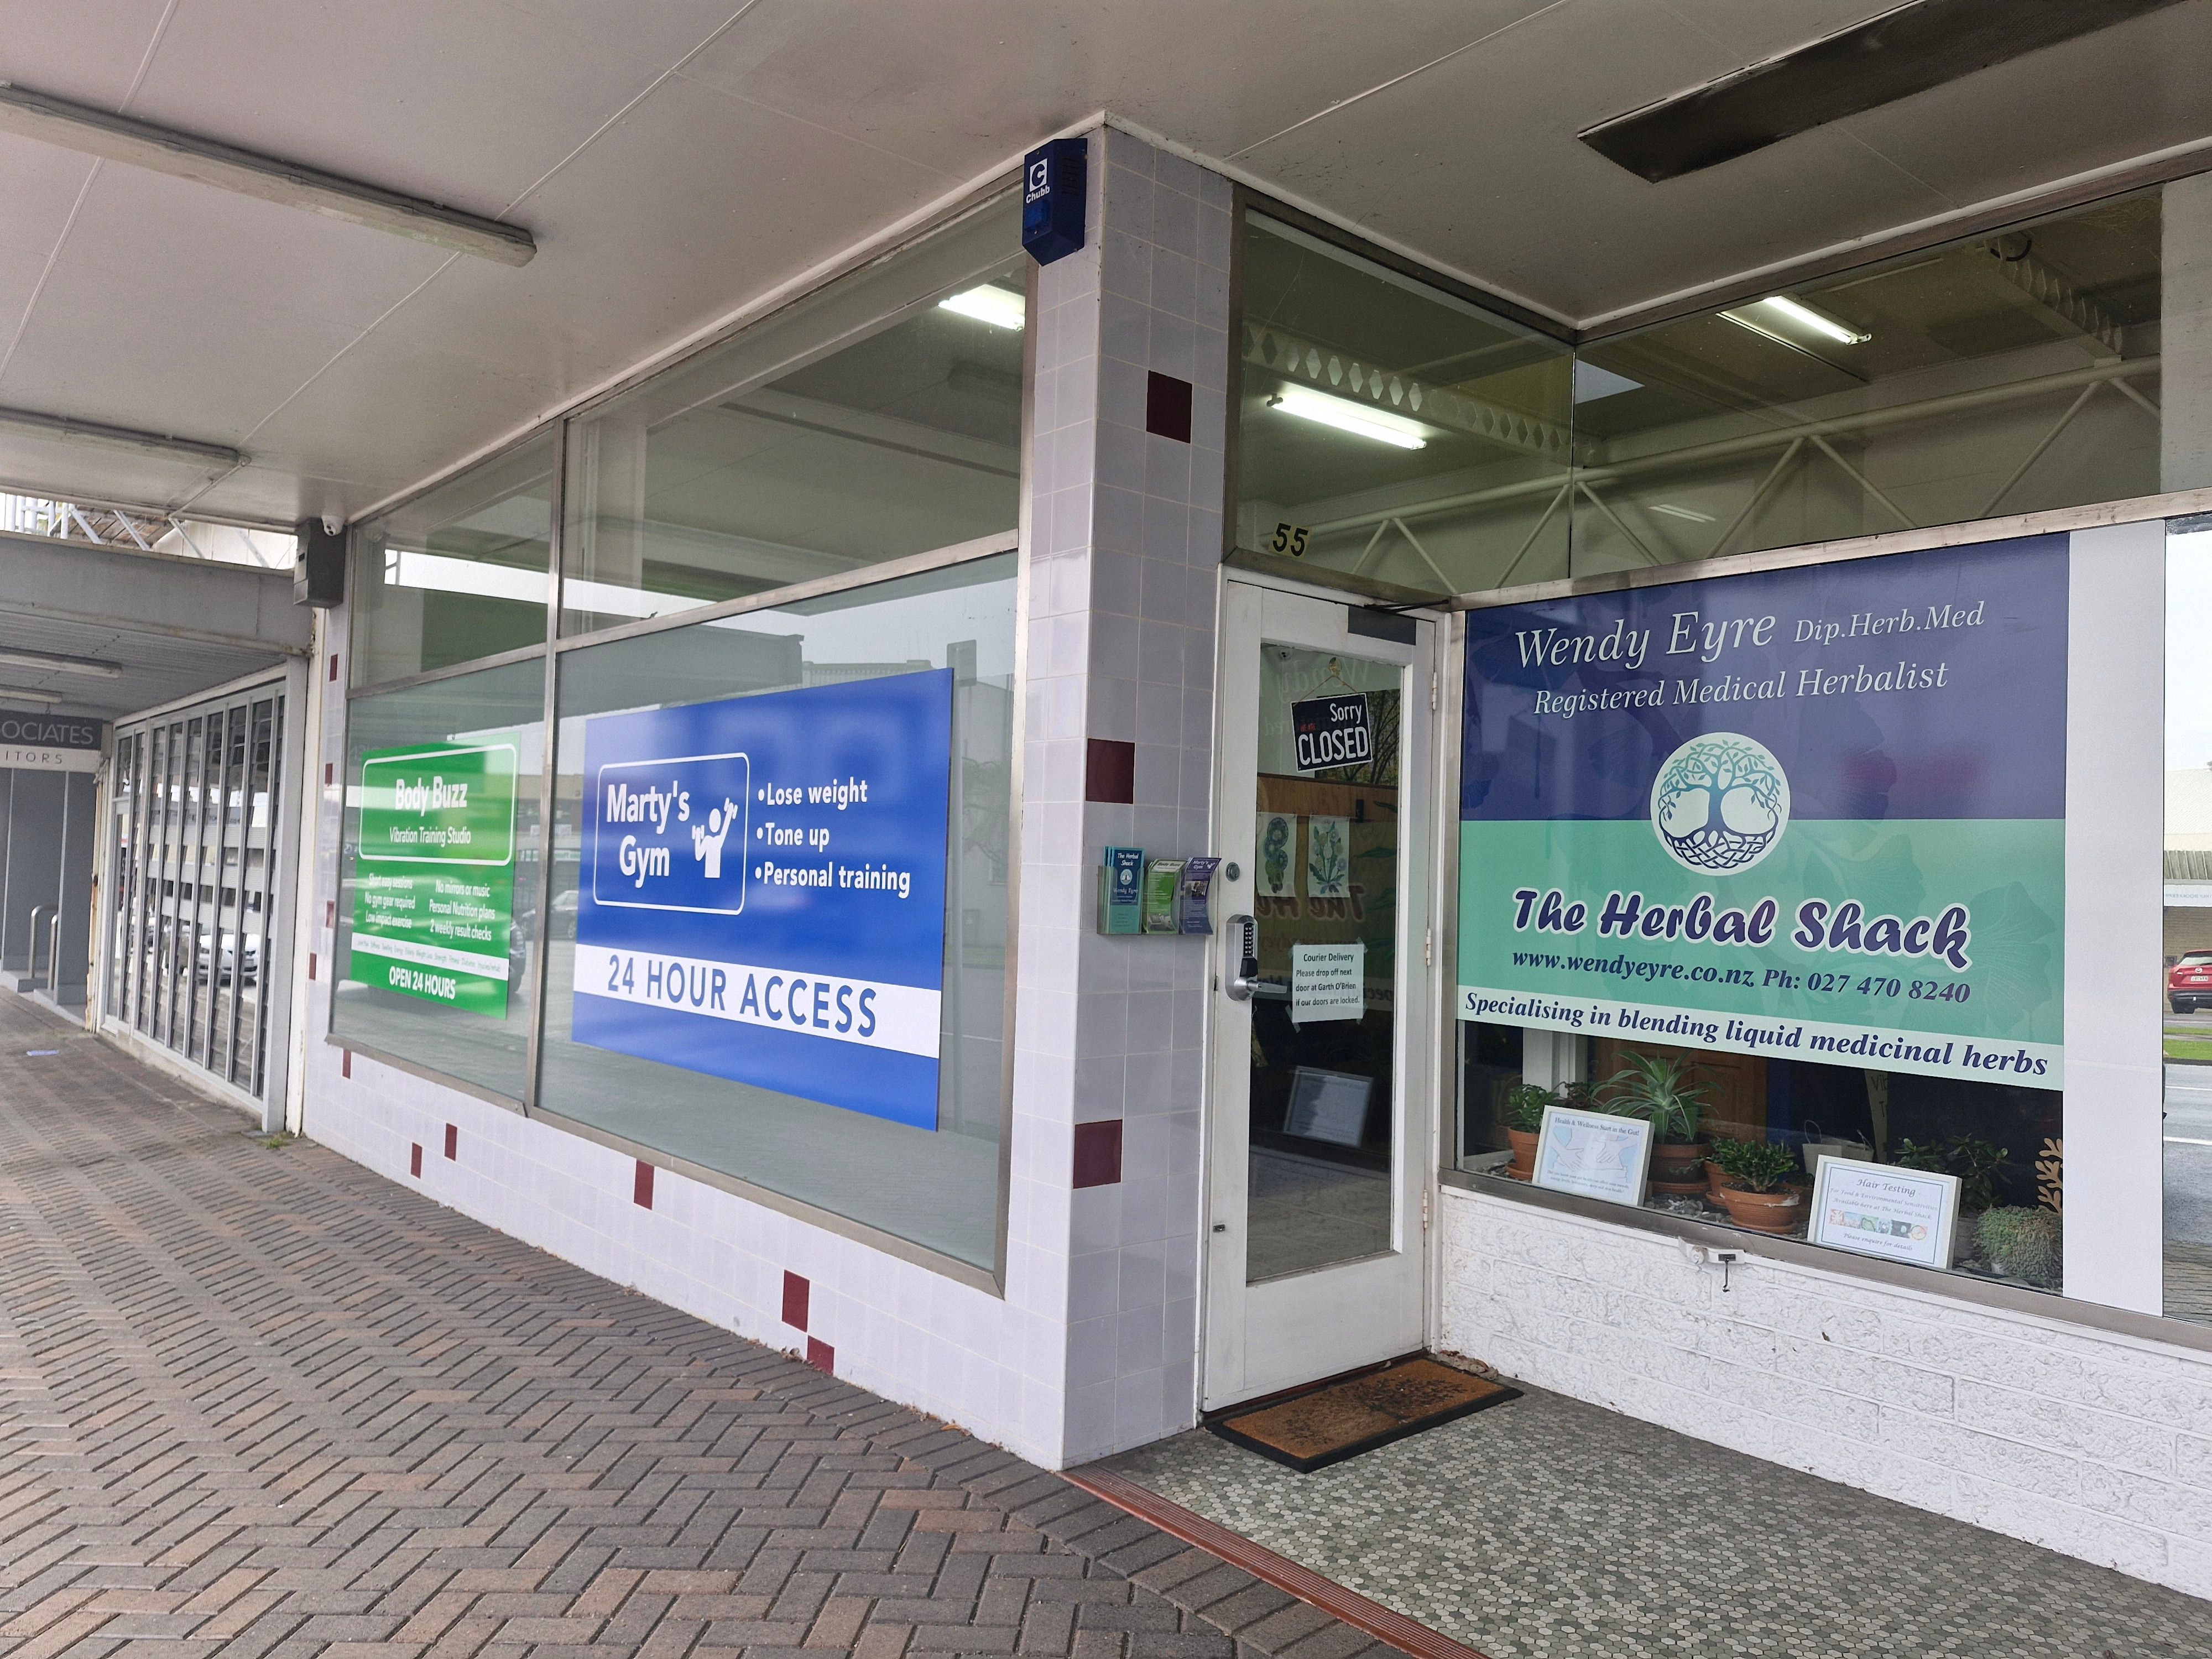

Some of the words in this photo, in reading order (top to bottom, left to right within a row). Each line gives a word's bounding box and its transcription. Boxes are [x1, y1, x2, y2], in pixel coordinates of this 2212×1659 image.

[1273, 523, 1308, 556] 55
[1515, 619, 1650, 669] Wendy
[1666, 611, 1776, 663] Eyre
[1794, 601, 1985, 645] Dip.Herb.Med
[1533, 680, 1665, 719] Registered
[1673, 671, 1787, 705] Medical
[1796, 661, 1949, 697] Herbalist
[1329, 703, 1362, 724] Sorry
[1, 721, 93, 744] OCIATES
[6, 750, 62, 764] ITORS
[1026, 738, 1050, 757] Chubb
[1298, 727, 1369, 765] CLOSED
[395, 778, 429, 817] Body
[432, 776, 468, 808] Buzz
[766, 782, 802, 805] Lose
[808, 776, 868, 811] weight
[607, 780, 690, 834] Marty's
[390, 827, 418, 843] Vibration
[419, 827, 446, 847] Training
[447, 826, 471, 844] Studio
[765, 822, 803, 846] Tone
[808, 827, 830, 852] up
[619, 835, 670, 889] Gym
[436, 879, 444, 893] No
[445, 880, 465, 895] mirrors
[465, 885, 472, 895] or
[473, 883, 490, 898] music
[764, 862, 833, 888] Personal
[838, 864, 911, 899] training
[365, 891, 372, 904] No
[394, 895, 415, 911] required
[429, 899, 452, 914] Personal
[452, 901, 478, 917] Nutrition
[478, 904, 495, 922] plans
[366, 910, 375, 923] Low
[430, 919, 435, 932] 2
[435, 920, 454, 939] weekly
[455, 923, 471, 938] result
[471, 924, 492, 941] checks
[1515, 890, 1585, 931] The
[1599, 892, 1776, 944] Herbal
[1794, 901, 1969, 969] Shack
[1303, 953, 1327, 962] Courier
[1328, 953, 1354, 963] Delivery
[389, 966, 411, 989] OPEN
[412, 971, 423, 992] 24
[425, 974, 456, 1000] HOURS
[1316, 969, 1329, 978] drop
[1512, 951, 1755, 987] www.wendyeyre.co.nz
[1761, 968, 1800, 989] Ph:
[1808, 973, 1851, 993] 027
[1856, 977, 1901, 997] 470
[1908, 980, 1970, 1003] 8240
[608, 954, 635, 994] 24
[647, 960, 726, 1011] HOUR
[739, 973, 877, 1037] ACCESS
[1318, 983, 1334, 991] Garth
[1340, 996, 1360, 1004] locked.
[1465, 992, 1584, 1027] Specialising
[1590, 1005, 1610, 1025] in
[1618, 1008, 1719, 1043] blending
[1725, 1020, 1803, 1051] liquid
[1810, 1034, 1954, 1065] medicinal
[1962, 1042, 2048, 1076] herbs
[1577, 1120, 1599, 1129] Wellness
[1856, 1178, 1880, 1189] Hair
[1882, 1183, 1916, 1197] Testing
[1860, 1193, 1903, 1204] Environmental
[1833, 1198, 1859, 1206] Available
[1892, 1208, 1914, 1216] Herbal
